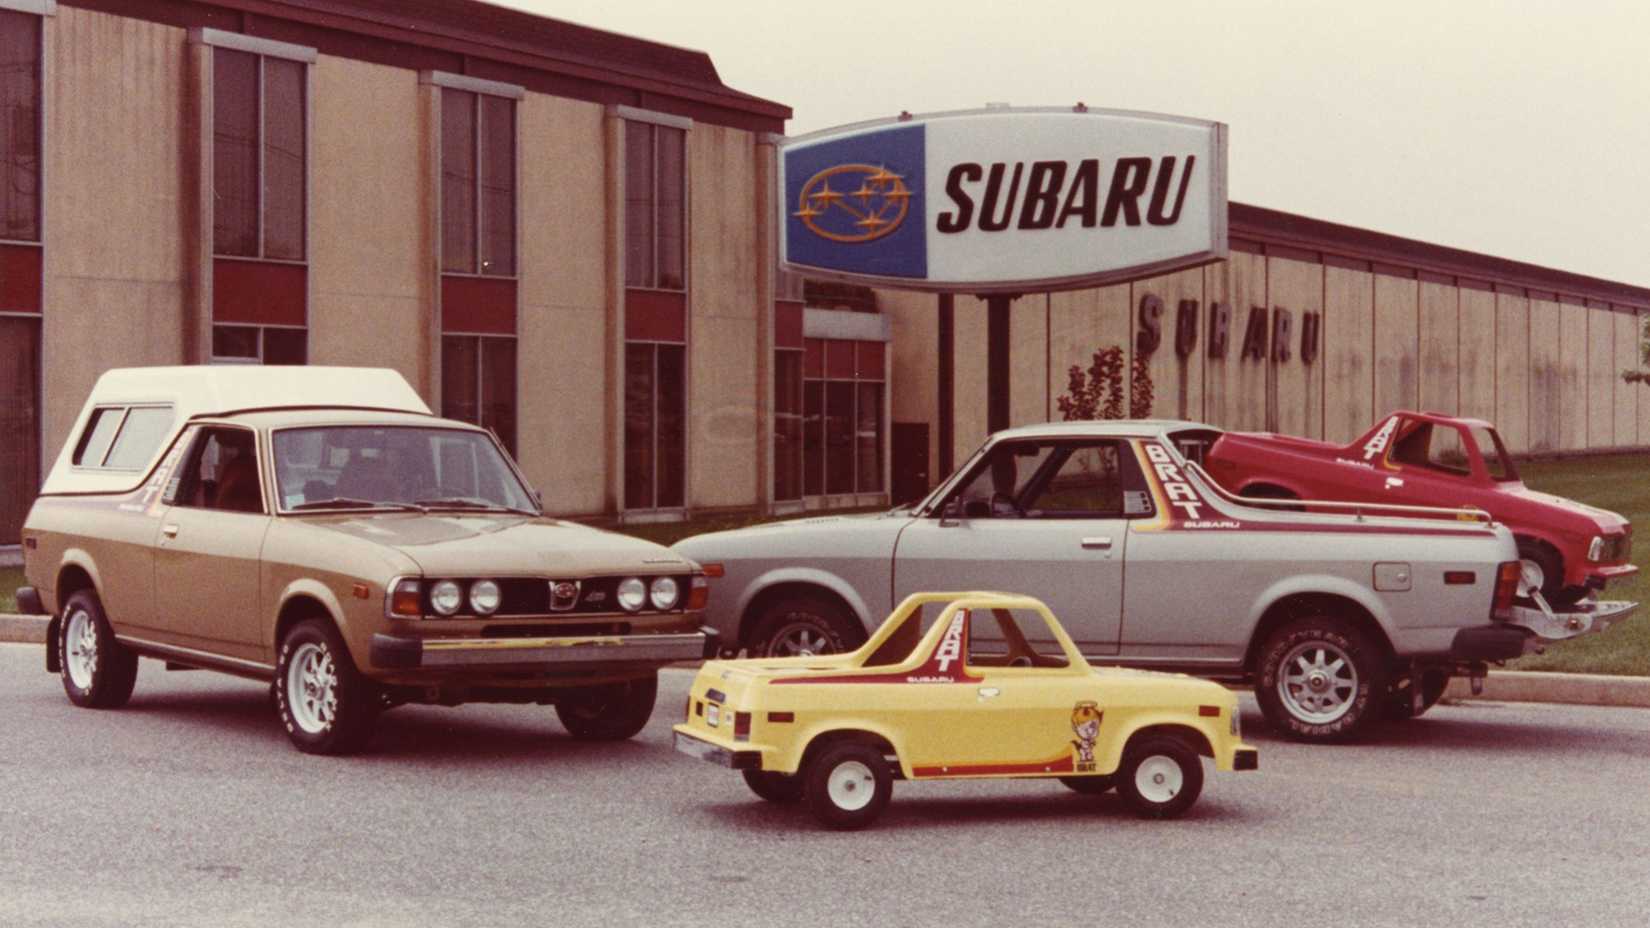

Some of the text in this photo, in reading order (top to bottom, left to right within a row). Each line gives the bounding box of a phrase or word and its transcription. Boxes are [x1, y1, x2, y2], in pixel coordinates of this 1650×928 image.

[937, 155, 1196, 233] SUBARU
[1136, 294, 1320, 365] SUBARU
[1144, 444, 1202, 519] BRAT
[934, 609, 966, 672] BRAT
